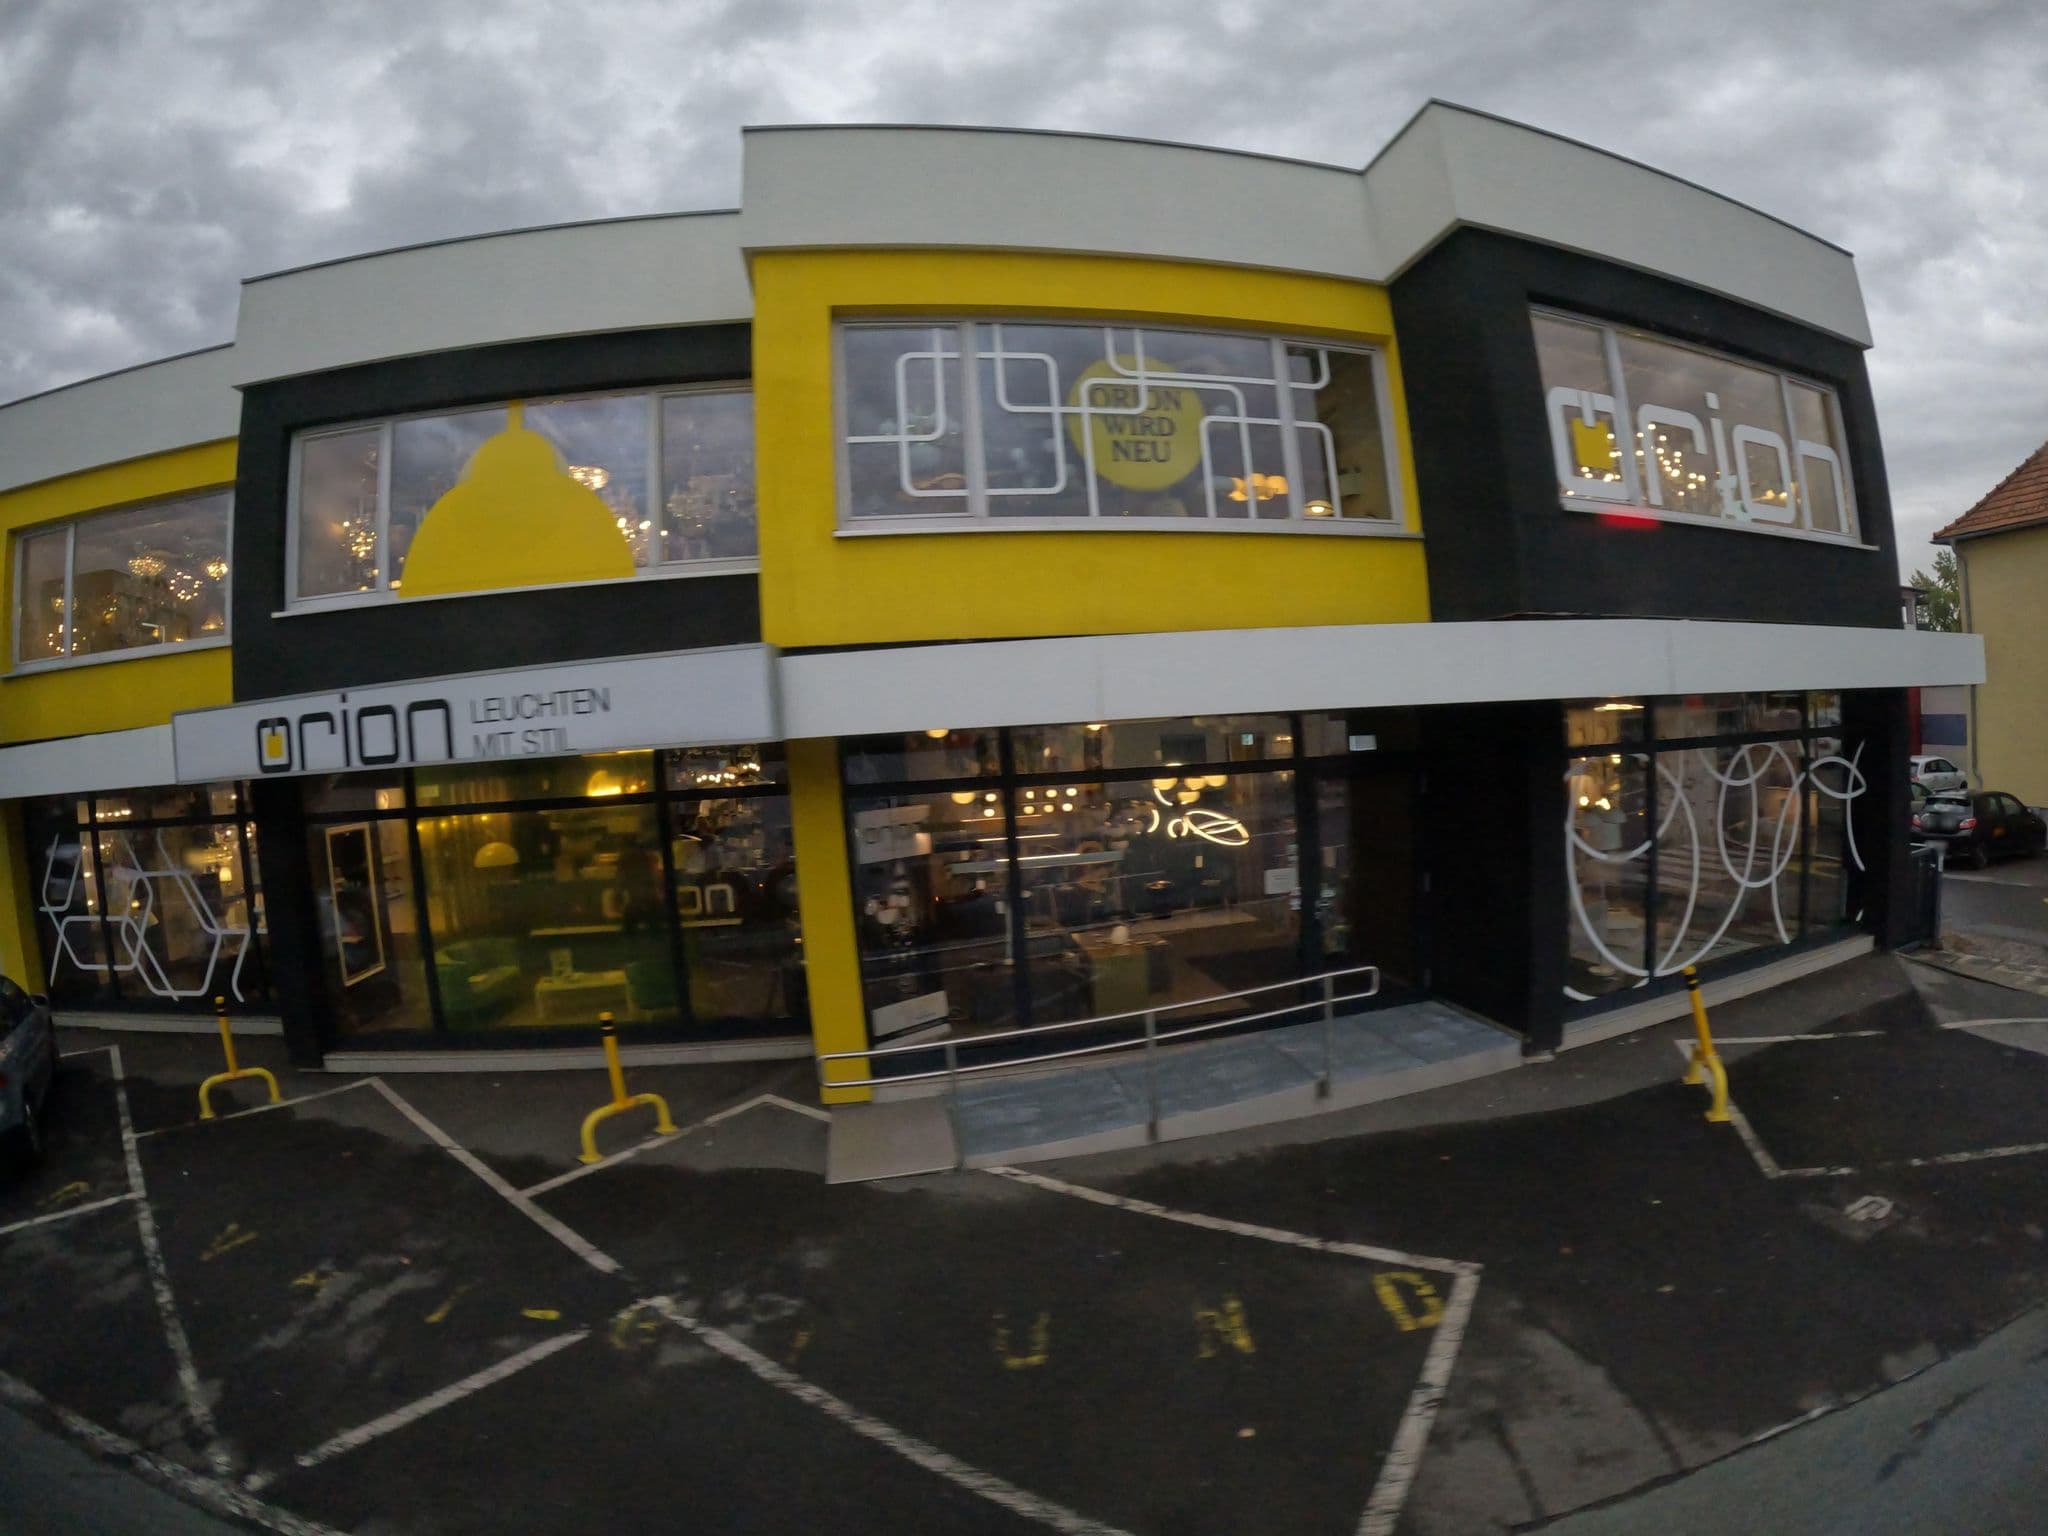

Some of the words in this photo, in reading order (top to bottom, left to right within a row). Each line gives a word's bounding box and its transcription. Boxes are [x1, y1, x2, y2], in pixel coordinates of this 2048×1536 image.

[1088, 385, 1181, 411] ORION
[1101, 414, 1176, 437] WIRD
[1111, 439, 1171, 463] NEU
[1546, 386, 1850, 534] orion
[469, 686, 611, 724] LEUCHTEN
[256, 691, 454, 774] orion
[472, 731, 515, 758] MIT
[520, 727, 578, 755] STIL
